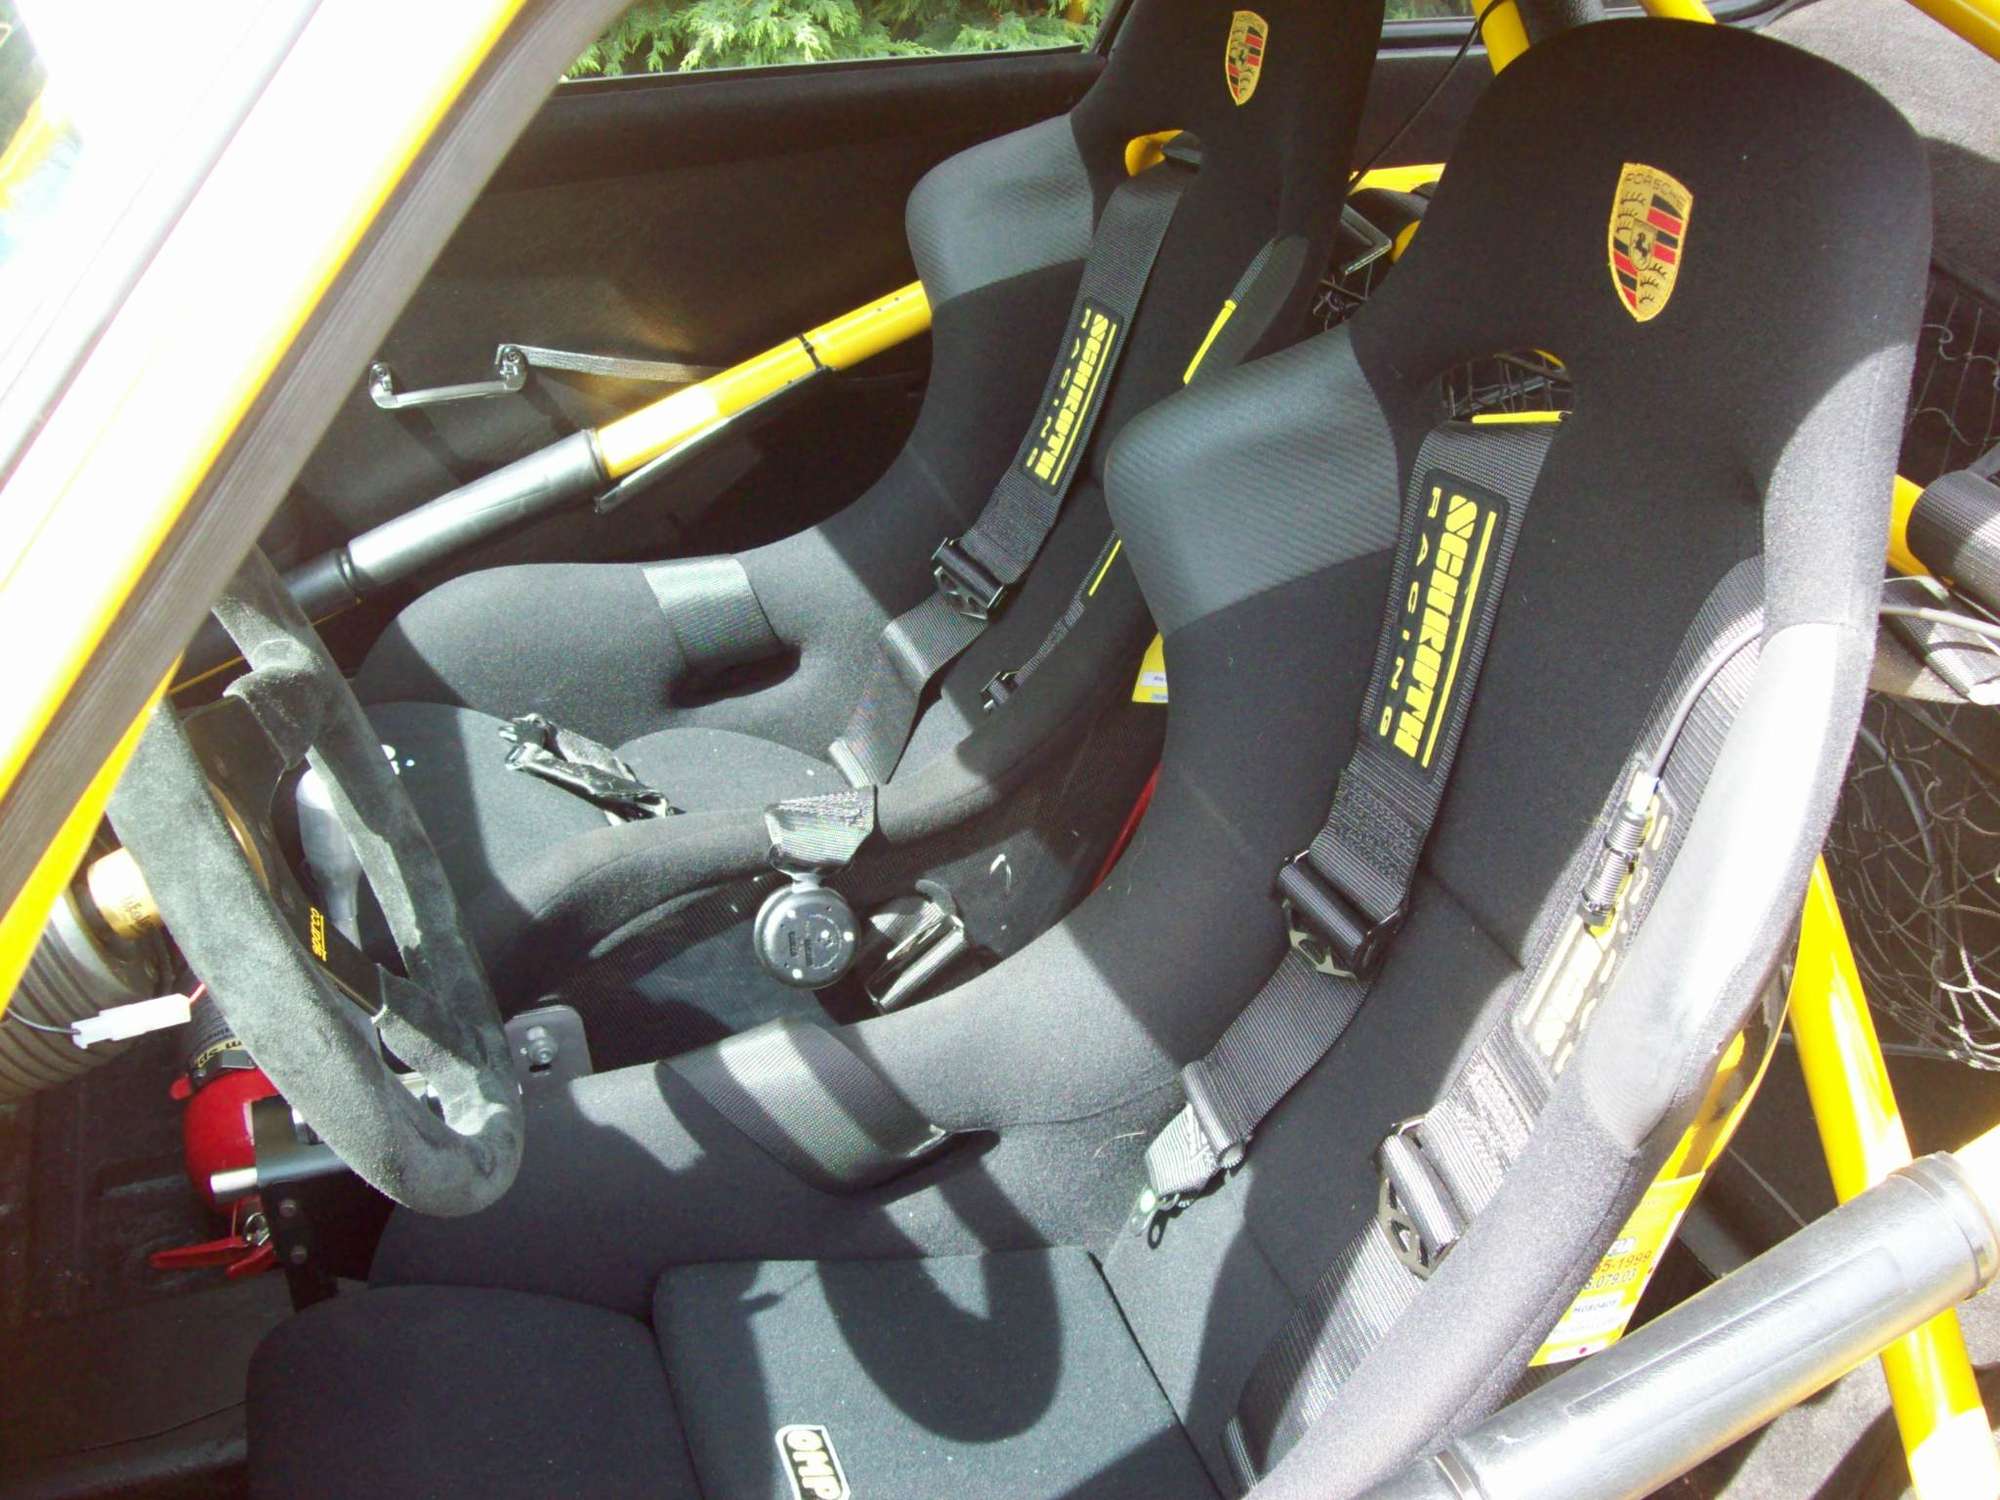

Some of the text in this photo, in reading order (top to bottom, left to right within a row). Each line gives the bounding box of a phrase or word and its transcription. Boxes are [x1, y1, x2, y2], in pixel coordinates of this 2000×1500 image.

[1034, 314, 1109, 480] SCHROTH
[1379, 486, 1441, 737] RACING
[1393, 494, 1478, 758] SCHROTH
[786, 1429, 842, 1500] OMP
